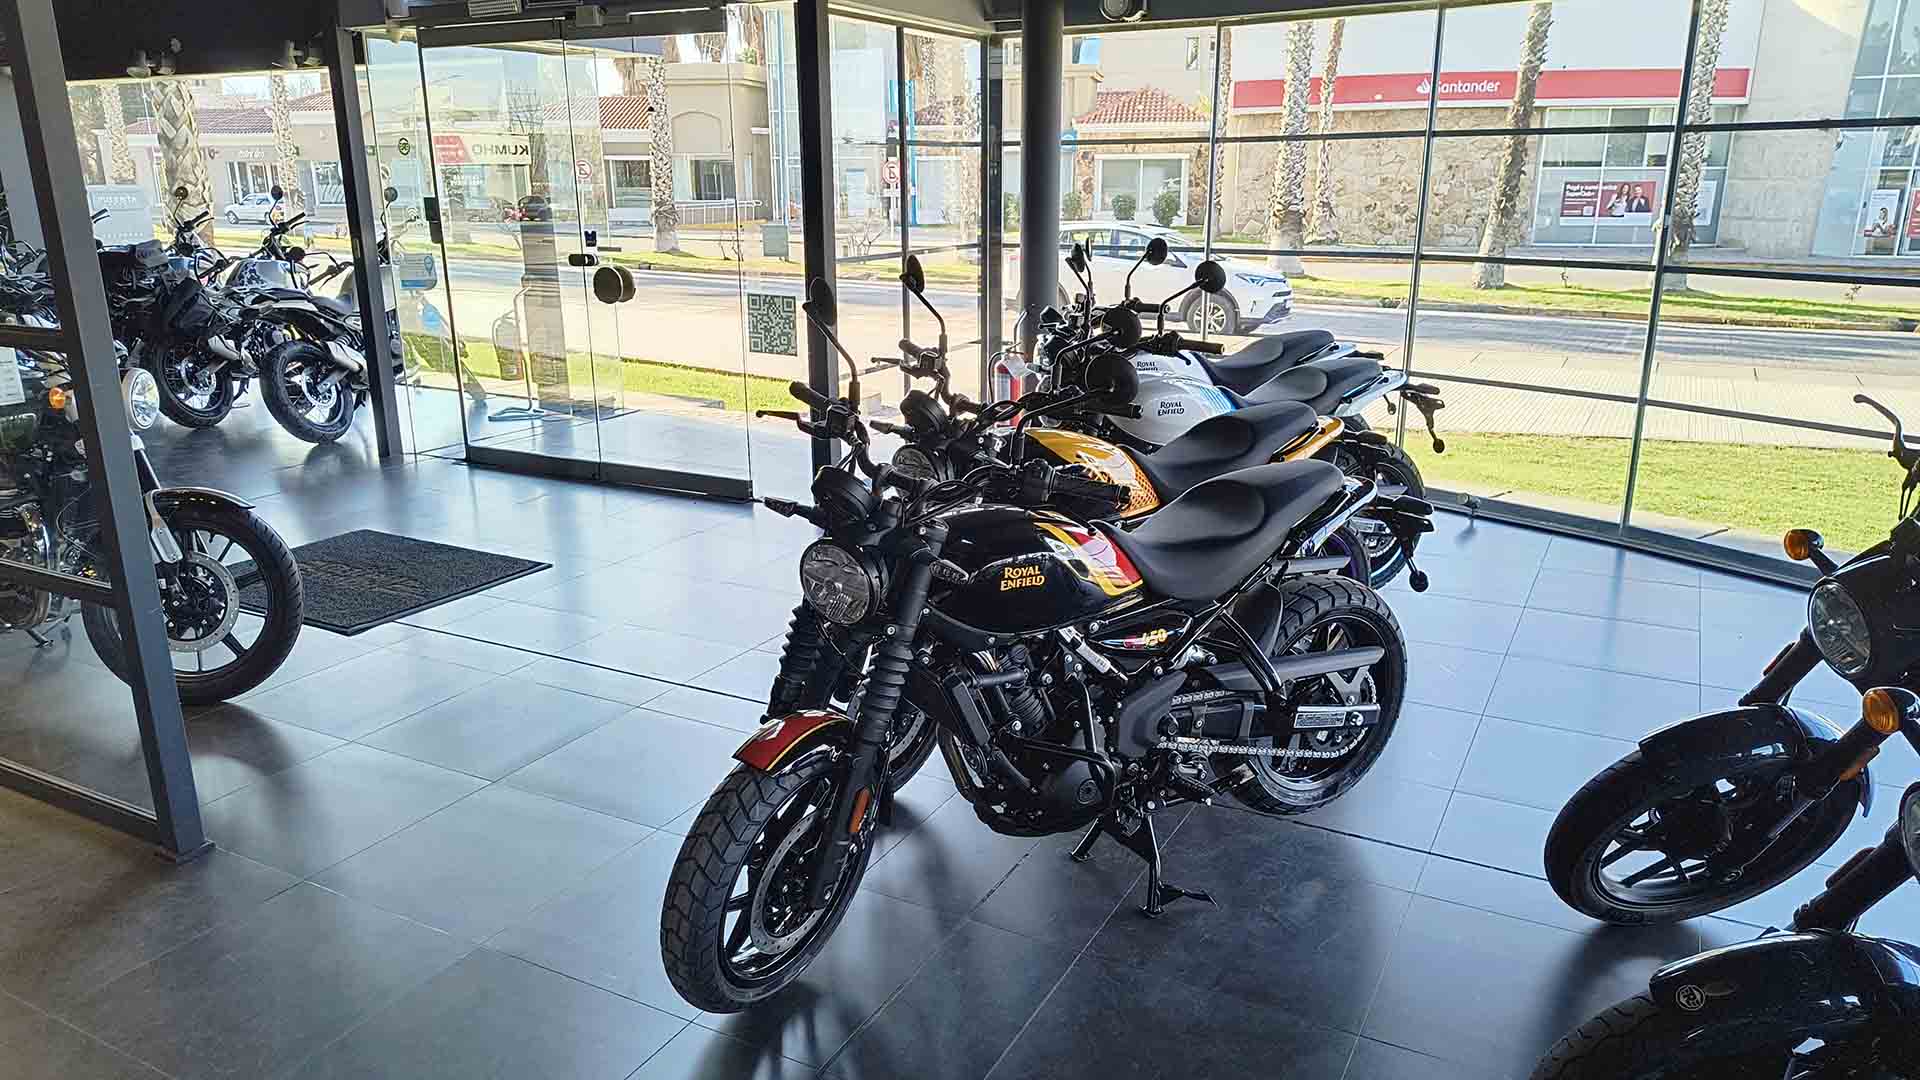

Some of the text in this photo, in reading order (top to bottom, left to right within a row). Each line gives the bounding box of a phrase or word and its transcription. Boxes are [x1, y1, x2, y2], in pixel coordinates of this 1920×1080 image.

[1160, 401, 1183, 410] ROYAL
[1157, 407, 1185, 417] ENFIELD
[1004, 565, 1041, 579] ROYAL
[1000, 575, 1045, 591] ENFIELD
